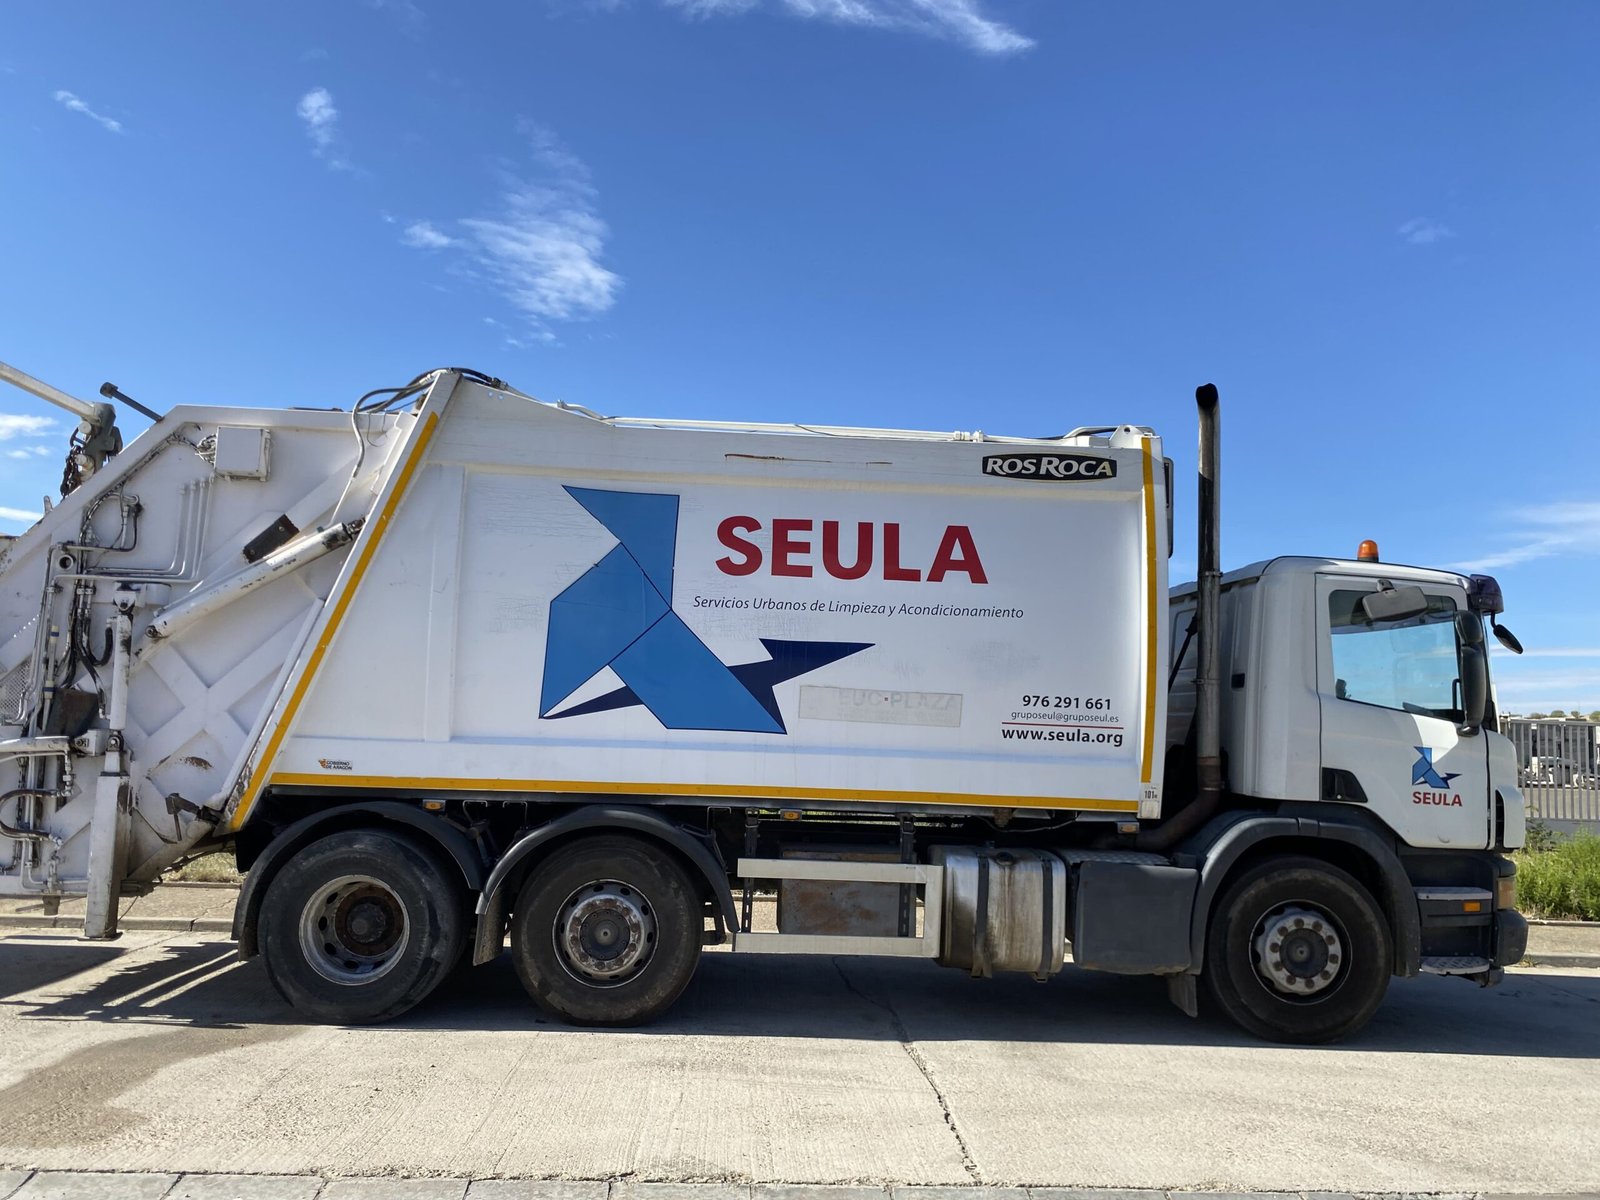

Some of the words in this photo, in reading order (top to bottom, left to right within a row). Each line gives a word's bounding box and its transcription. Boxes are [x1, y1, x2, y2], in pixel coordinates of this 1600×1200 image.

[715, 515, 989, 584] SEULA
[693, 595, 750, 609] Servicios
[753, 597, 807, 611] Urbanos
[810, 599, 826, 612] de
[828, 600, 886, 615] Limpieza
[888, 605, 896, 618] y
[898, 603, 1024, 618] Acondicionamiento
[1022, 695, 1050, 708] 976
[1053, 696, 1080, 709] 291
[1085, 697, 1111, 710] 661
[1011, 711, 1119, 723] gruposeul@gruposeul.es
[1001, 728, 1123, 748] www.seula.org
[1412, 791, 1463, 807] SEULA
